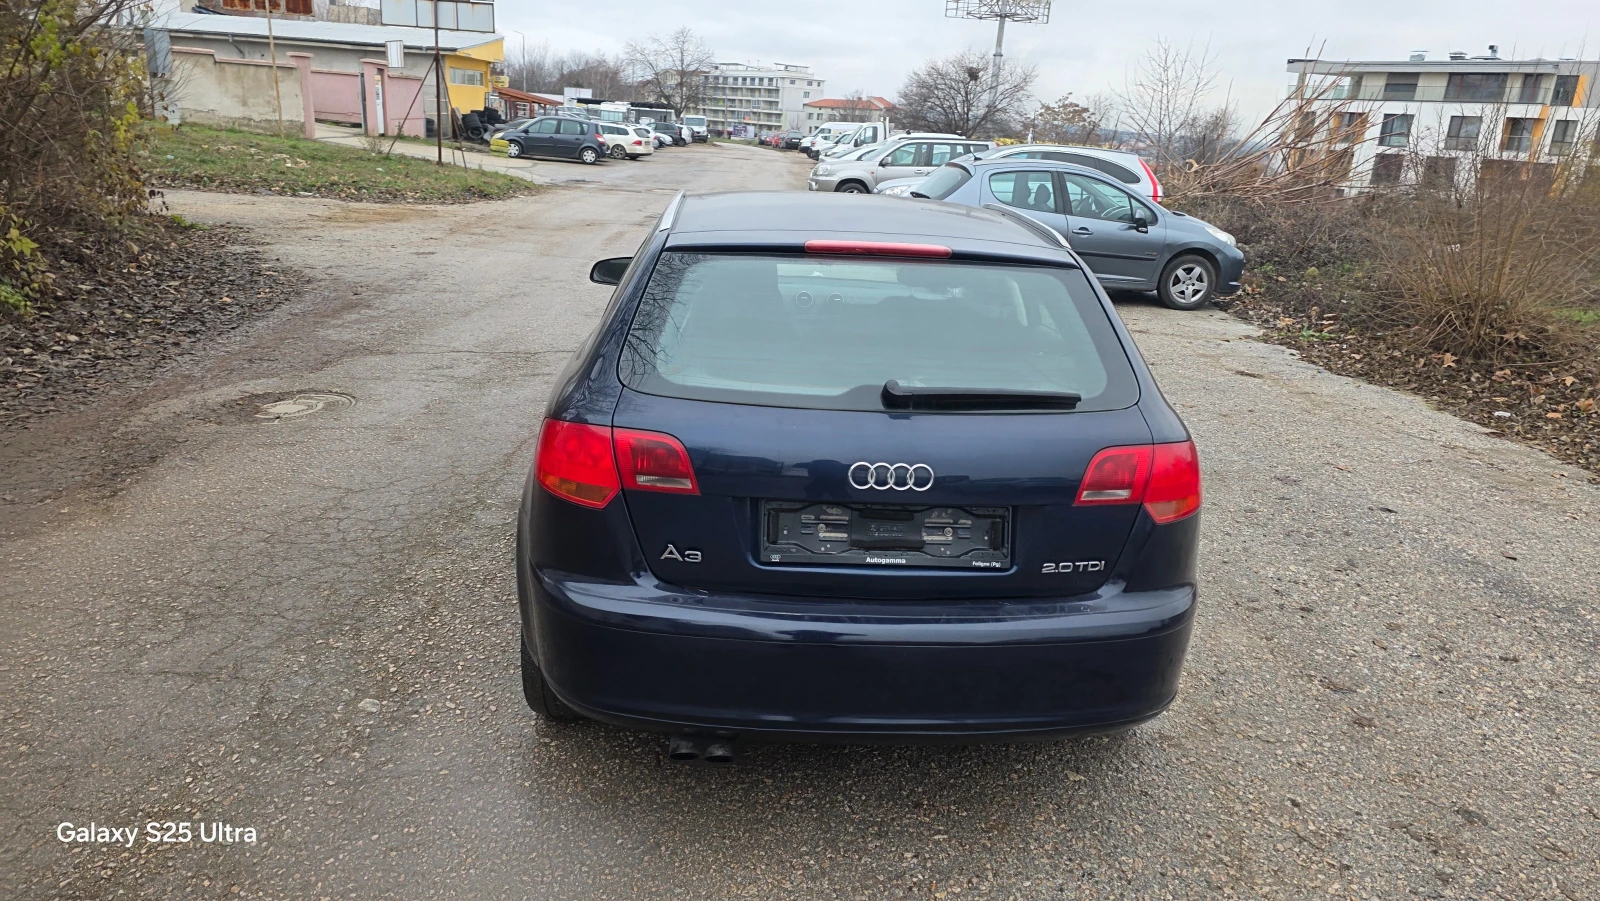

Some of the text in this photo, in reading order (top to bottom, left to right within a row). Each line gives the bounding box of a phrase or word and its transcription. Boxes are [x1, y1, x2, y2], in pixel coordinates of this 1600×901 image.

[660, 544, 702, 562] A3
[865, 556, 906, 564] Autogamma
[1041, 561, 1105, 573] 2.0 TDI
